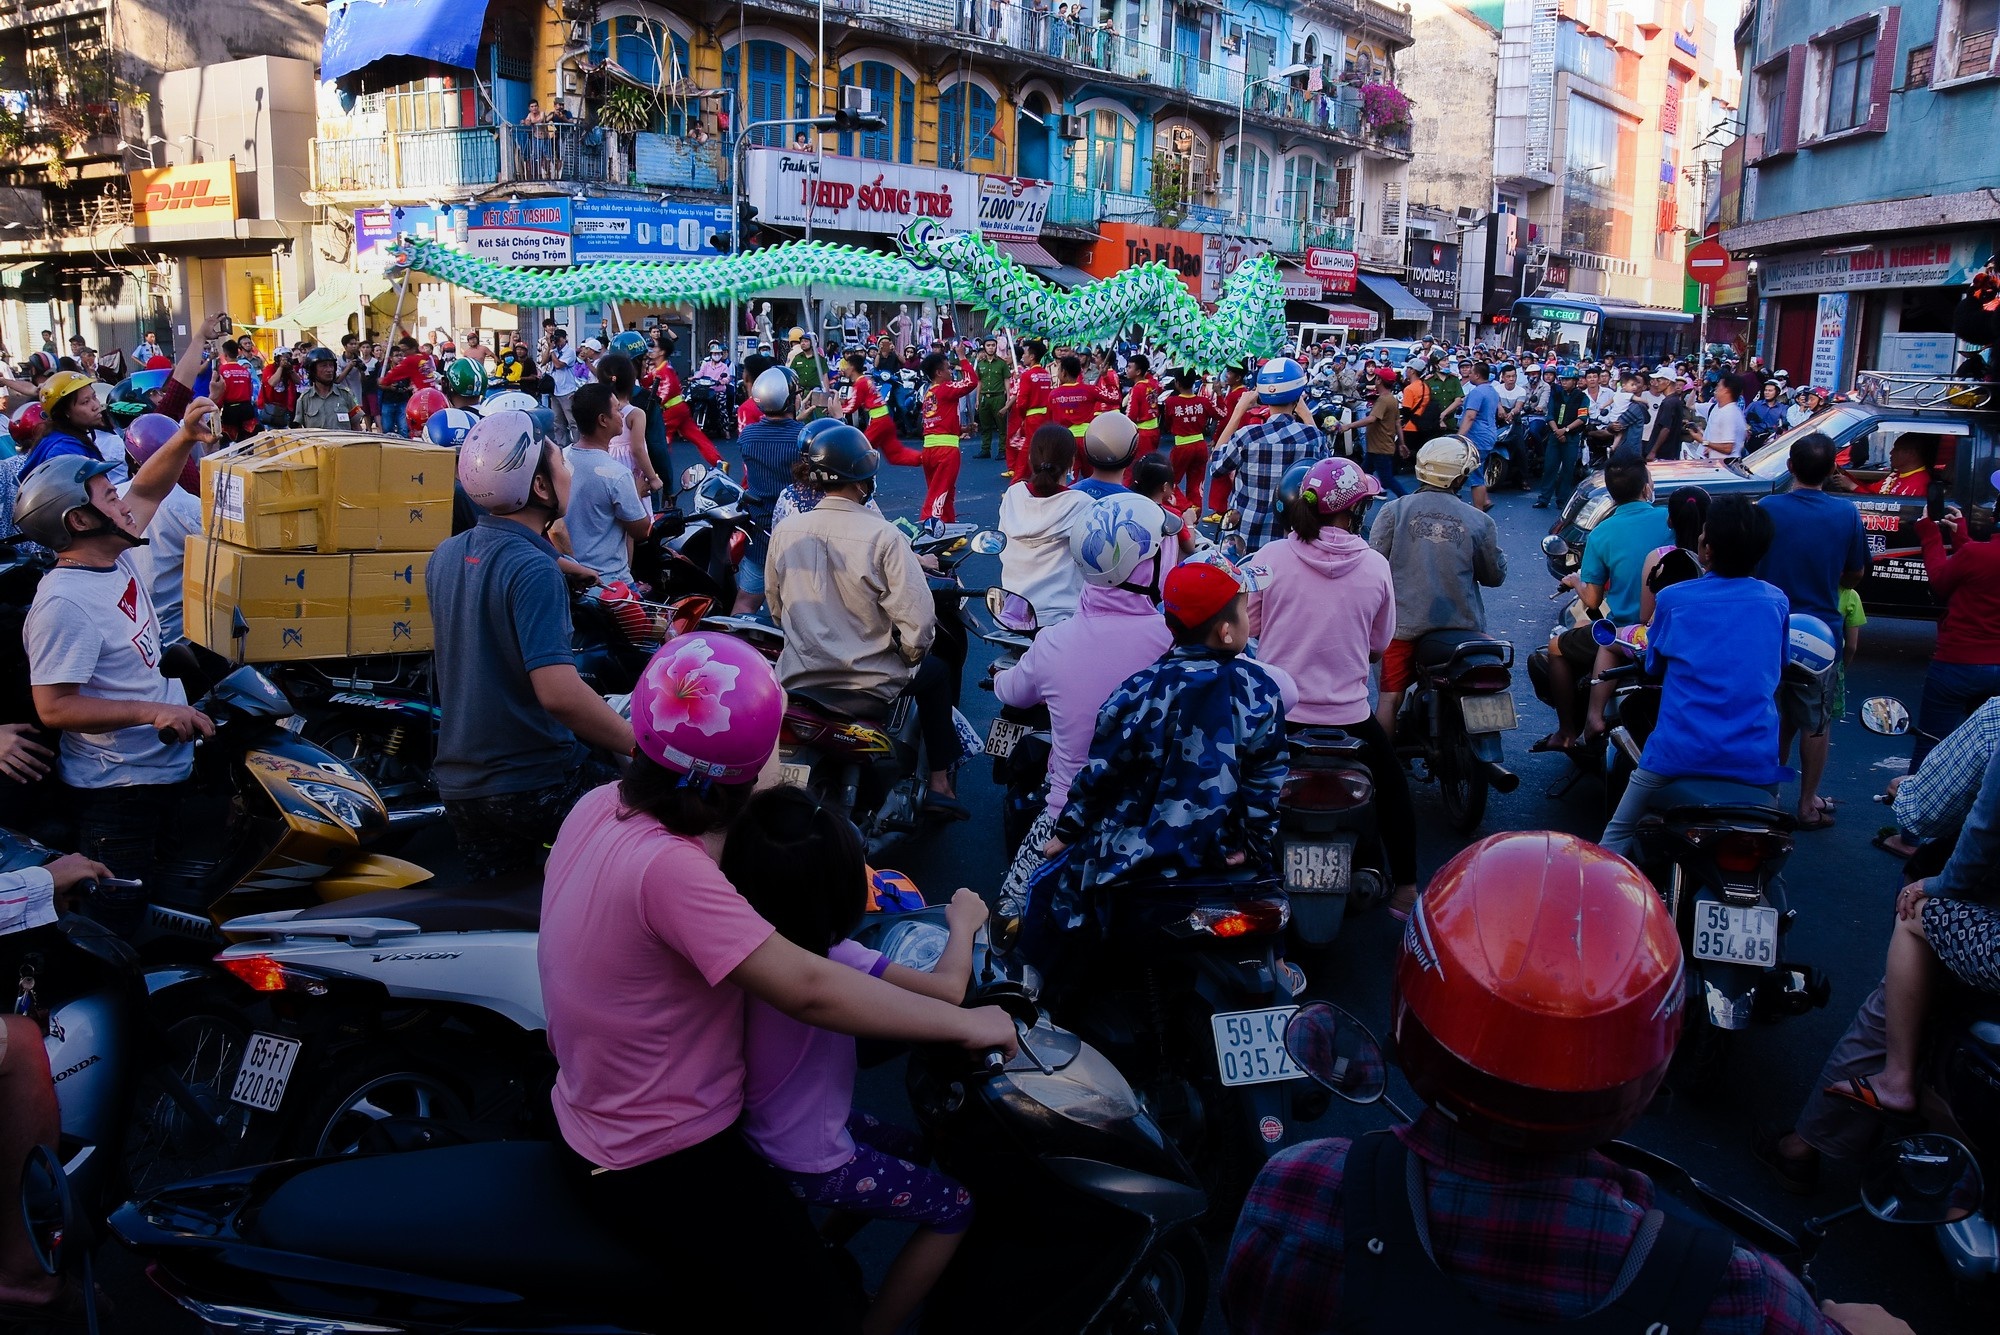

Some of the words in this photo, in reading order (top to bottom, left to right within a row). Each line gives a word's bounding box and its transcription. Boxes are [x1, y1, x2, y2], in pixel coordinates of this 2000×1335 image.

[145, 179, 215, 211] DHL
[858, 173, 911, 215] SỐNG
[914, 184, 953, 217] TRẺ
[483, 207, 500, 226] KÉT
[503, 207, 520, 225] SẮT
[523, 207, 561, 223] YASHIDA
[612, 204, 623, 212] được
[652, 207, 664, 215] Công
[979, 197, 1015, 220] 7.000
[980, 221, 993, 229] Nhận
[1003, 221, 1012, 229] Số
[478, 238, 493, 248] Két
[495, 237, 510, 247] Sắt
[512, 235, 540, 247] Chống
[543, 236, 566, 247] Cháy
[512, 250, 540, 261] Chống
[543, 250, 566, 261] Trộm
[1319, 255, 1333, 265] LINH
[1826, 259, 1834, 273] IN
[1850, 250, 1884, 271] KHOA
[1413, 265, 1444, 284] royaltea
[1880, 271, 1893, 283] Email
[1413, 287, 1421, 297] TEA
[1442, 290, 1454, 300] JUICE
[1585, 311, 1598, 323] 01
[449, 370, 460, 386] Grab
[109, 401, 147, 413] 46
[152, 910, 213, 939] YAMAHA
[1699, 931, 1770, 961] 354.85
[370, 952, 464, 963] VISION
[250, 1037, 290, 1073] 65-F1
[234, 1069, 283, 1107] 320.86
